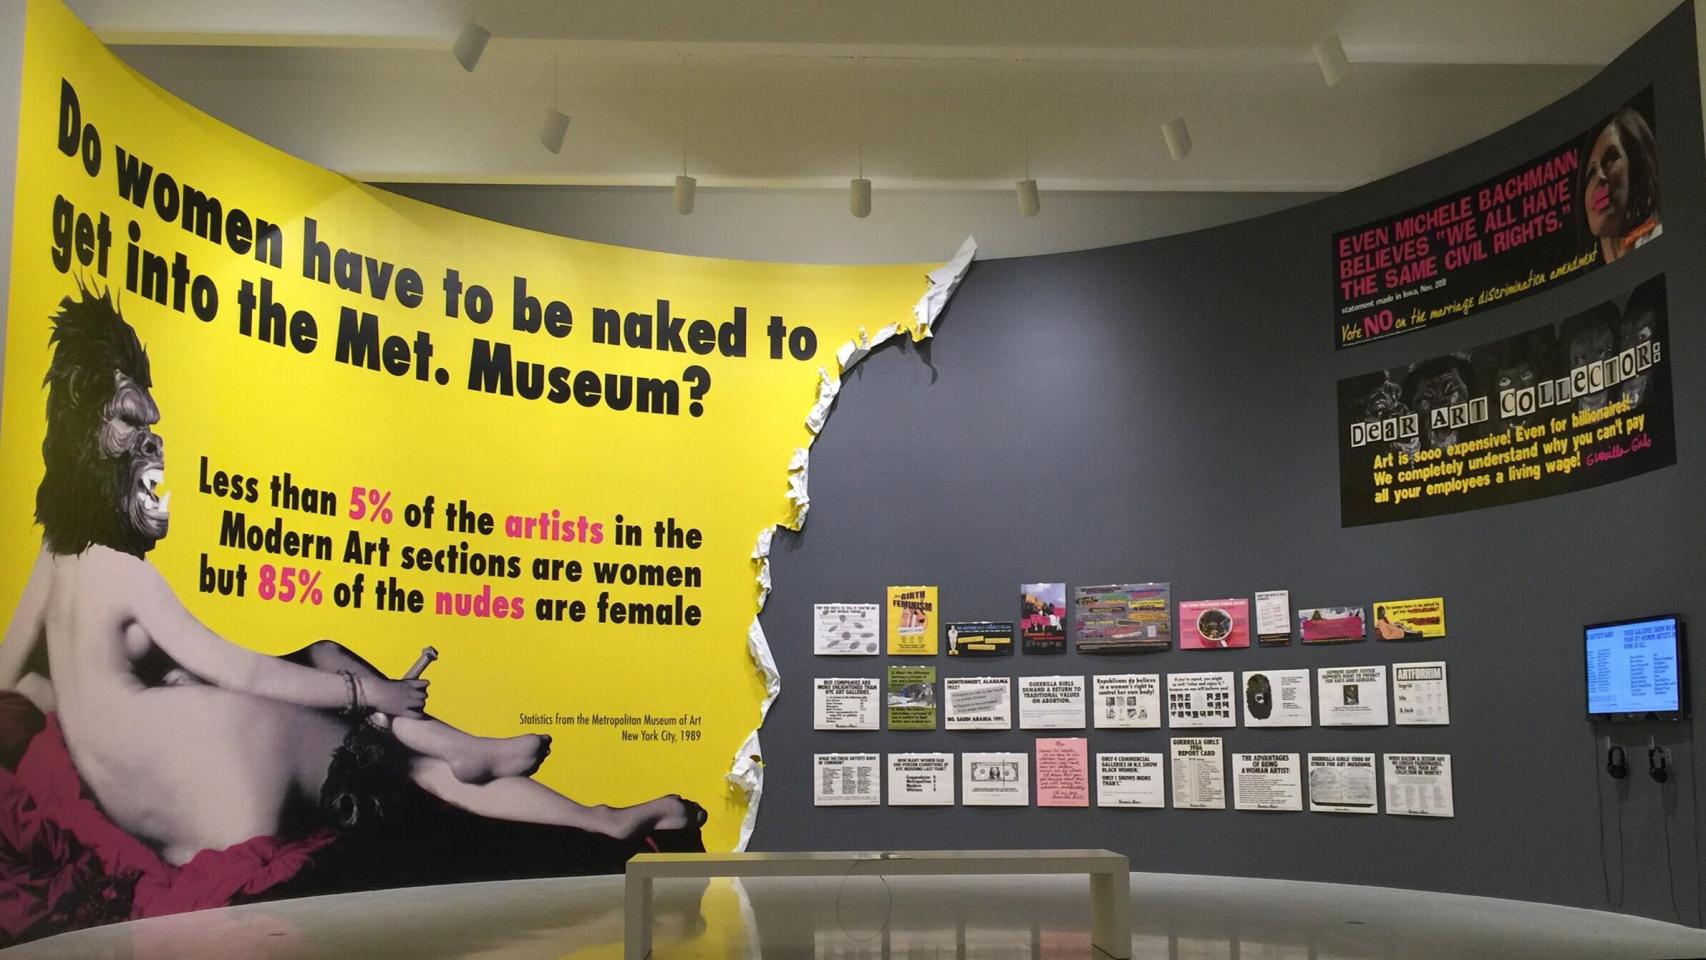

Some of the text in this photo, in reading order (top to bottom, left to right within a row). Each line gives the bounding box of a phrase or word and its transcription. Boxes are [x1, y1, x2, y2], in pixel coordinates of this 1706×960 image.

[57, 77, 817, 361] Do women have to be naked to
[1339, 149, 1578, 258] EVEN MICHELE BACHMANN
[1340, 178, 1571, 280] BELIEVES "WE ALL HAVE
[52, 194, 711, 417] get into the Met. Museum?
[1341, 275, 1378, 300] THE
[1385, 256, 1437, 289] SAME
[1445, 239, 1488, 270] CIVIL
[1341, 241, 1599, 342] Vote NO on the marriage discrimination amendment
[1341, 300, 1374, 314] statement
[1376, 293, 1394, 306] made
[1395, 292, 1402, 301] in
[1374, 454, 1394, 470] Art
[1398, 451, 1409, 465] is
[1414, 447, 1442, 463] sooo
[1447, 430, 1511, 460] expensive!
[1515, 426, 1546, 447] Even
[1550, 418, 1567, 434] for
[1374, 413, 1646, 487] We completely understand why you can't pay
[1431, 396, 1488, 430] ART
[200, 456, 702, 550] Less than 5% of the artists in the
[1374, 451, 1581, 505] all your employees a living wage!
[219, 510, 702, 588] Modern Art sections are women
[200, 553, 702, 627] but 85% of the nudes are female
[520, 713, 701, 728] Statistics from the Metropolitan Museum of Art
[622, 730, 701, 743] New York City, 1989
